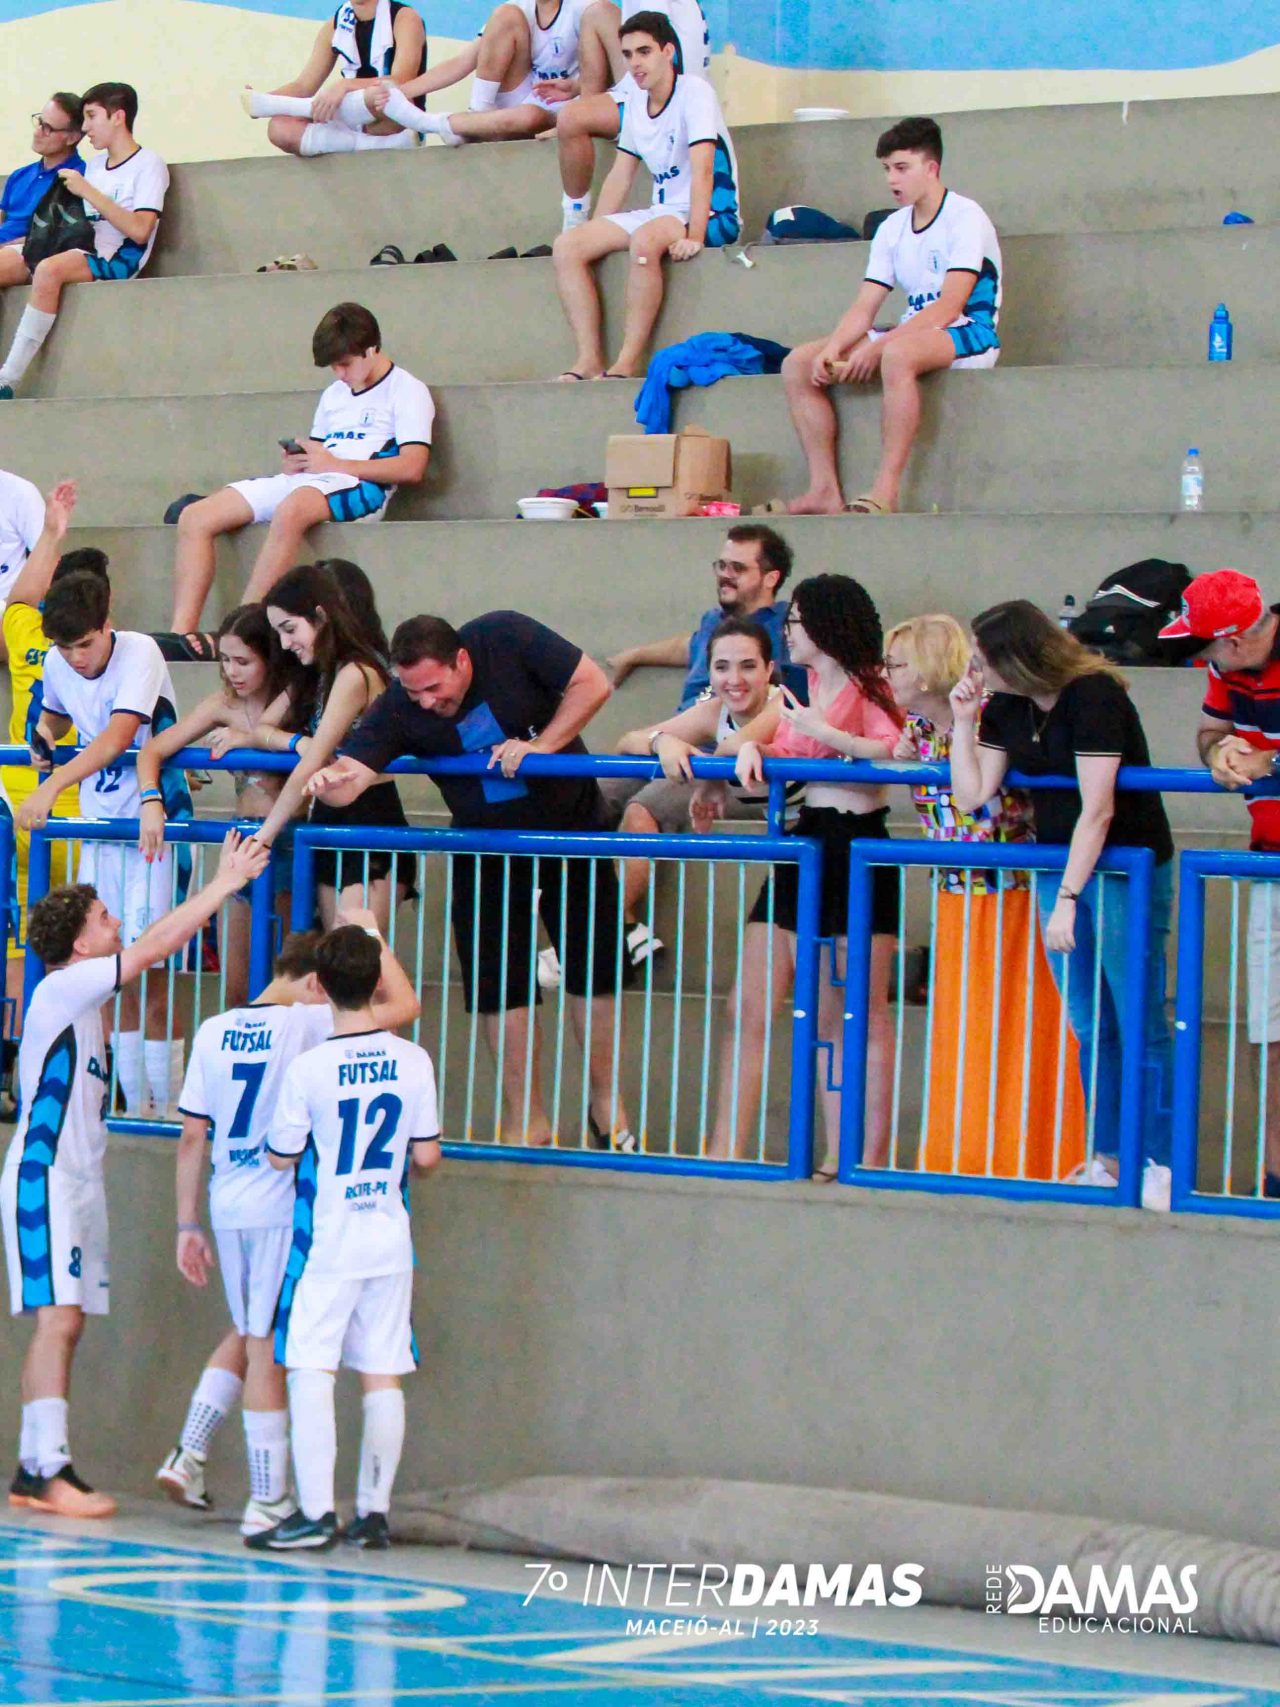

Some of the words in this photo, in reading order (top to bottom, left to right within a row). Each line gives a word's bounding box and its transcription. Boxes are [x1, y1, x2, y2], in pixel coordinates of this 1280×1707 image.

[221, 1030, 272, 1053] FUTSAL
[338, 1059, 399, 1087] FUTSAL
[227, 1061, 268, 1139] 7
[335, 1092, 403, 1176] 12
